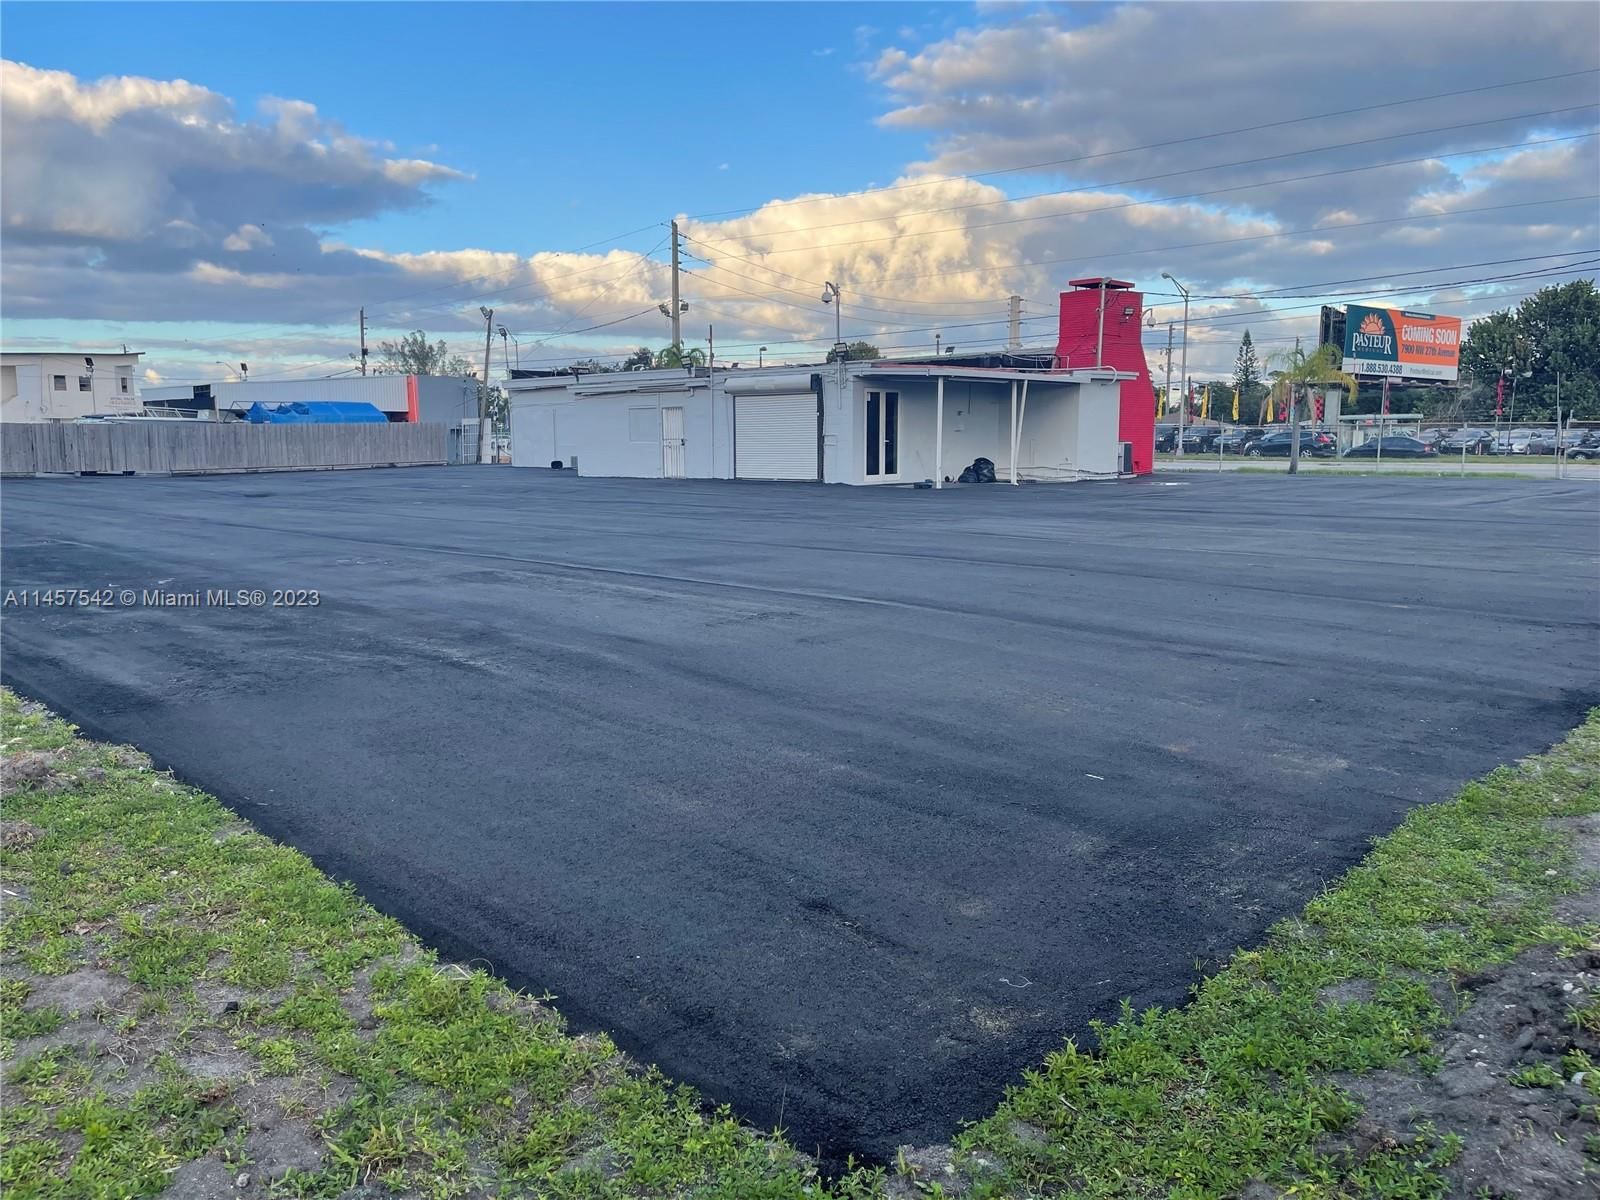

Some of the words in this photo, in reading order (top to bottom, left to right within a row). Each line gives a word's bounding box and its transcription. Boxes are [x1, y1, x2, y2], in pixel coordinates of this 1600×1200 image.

[1352, 332, 1391, 354] PASTEUR
[1402, 325, 1433, 342] COMING
[1436, 328, 1457, 345] SOON
